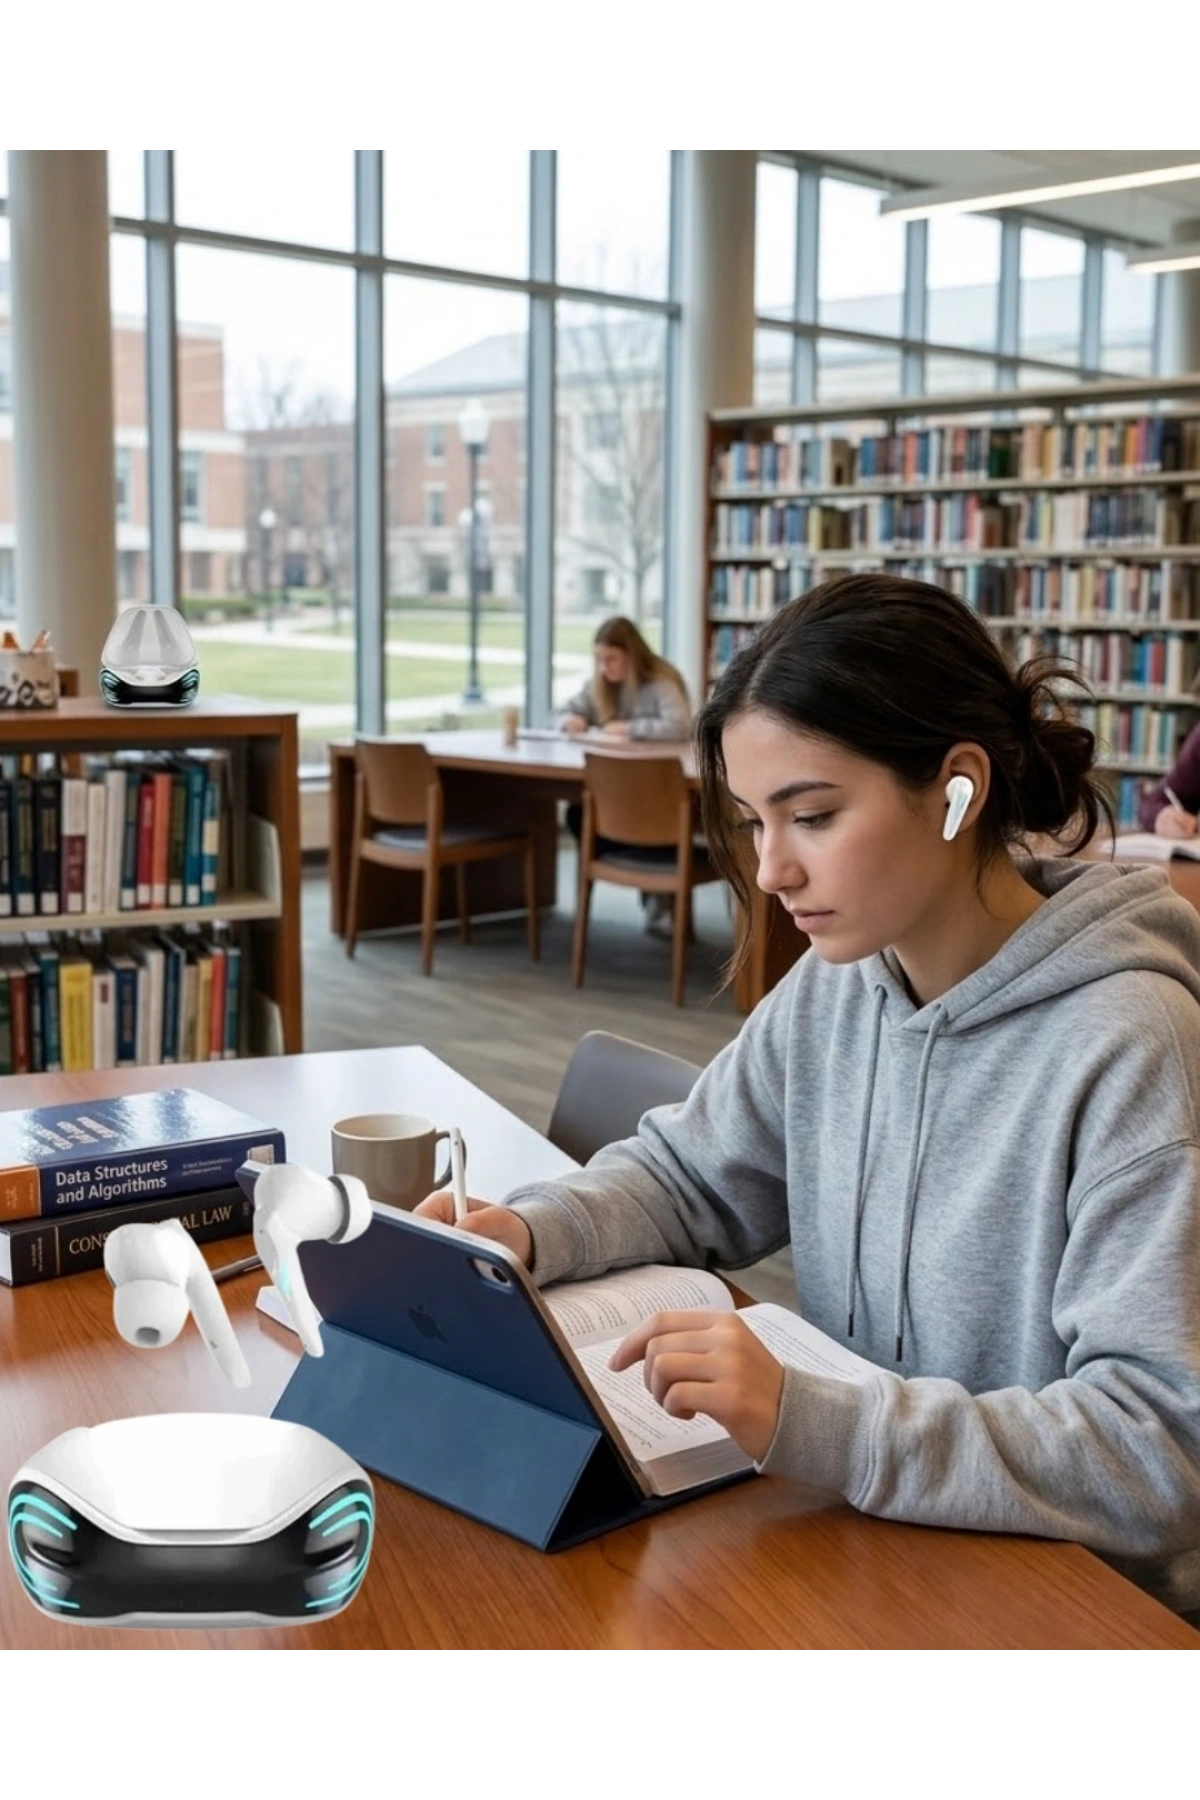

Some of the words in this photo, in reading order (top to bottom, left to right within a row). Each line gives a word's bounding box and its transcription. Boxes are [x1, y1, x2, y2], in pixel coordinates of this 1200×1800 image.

[56, 1170, 91, 1187] Data
[94, 1159, 168, 1181] Structures
[56, 1186, 84, 1204] and
[88, 1177, 167, 1201] Algorithms
[202, 1205, 232, 1225] LAW
